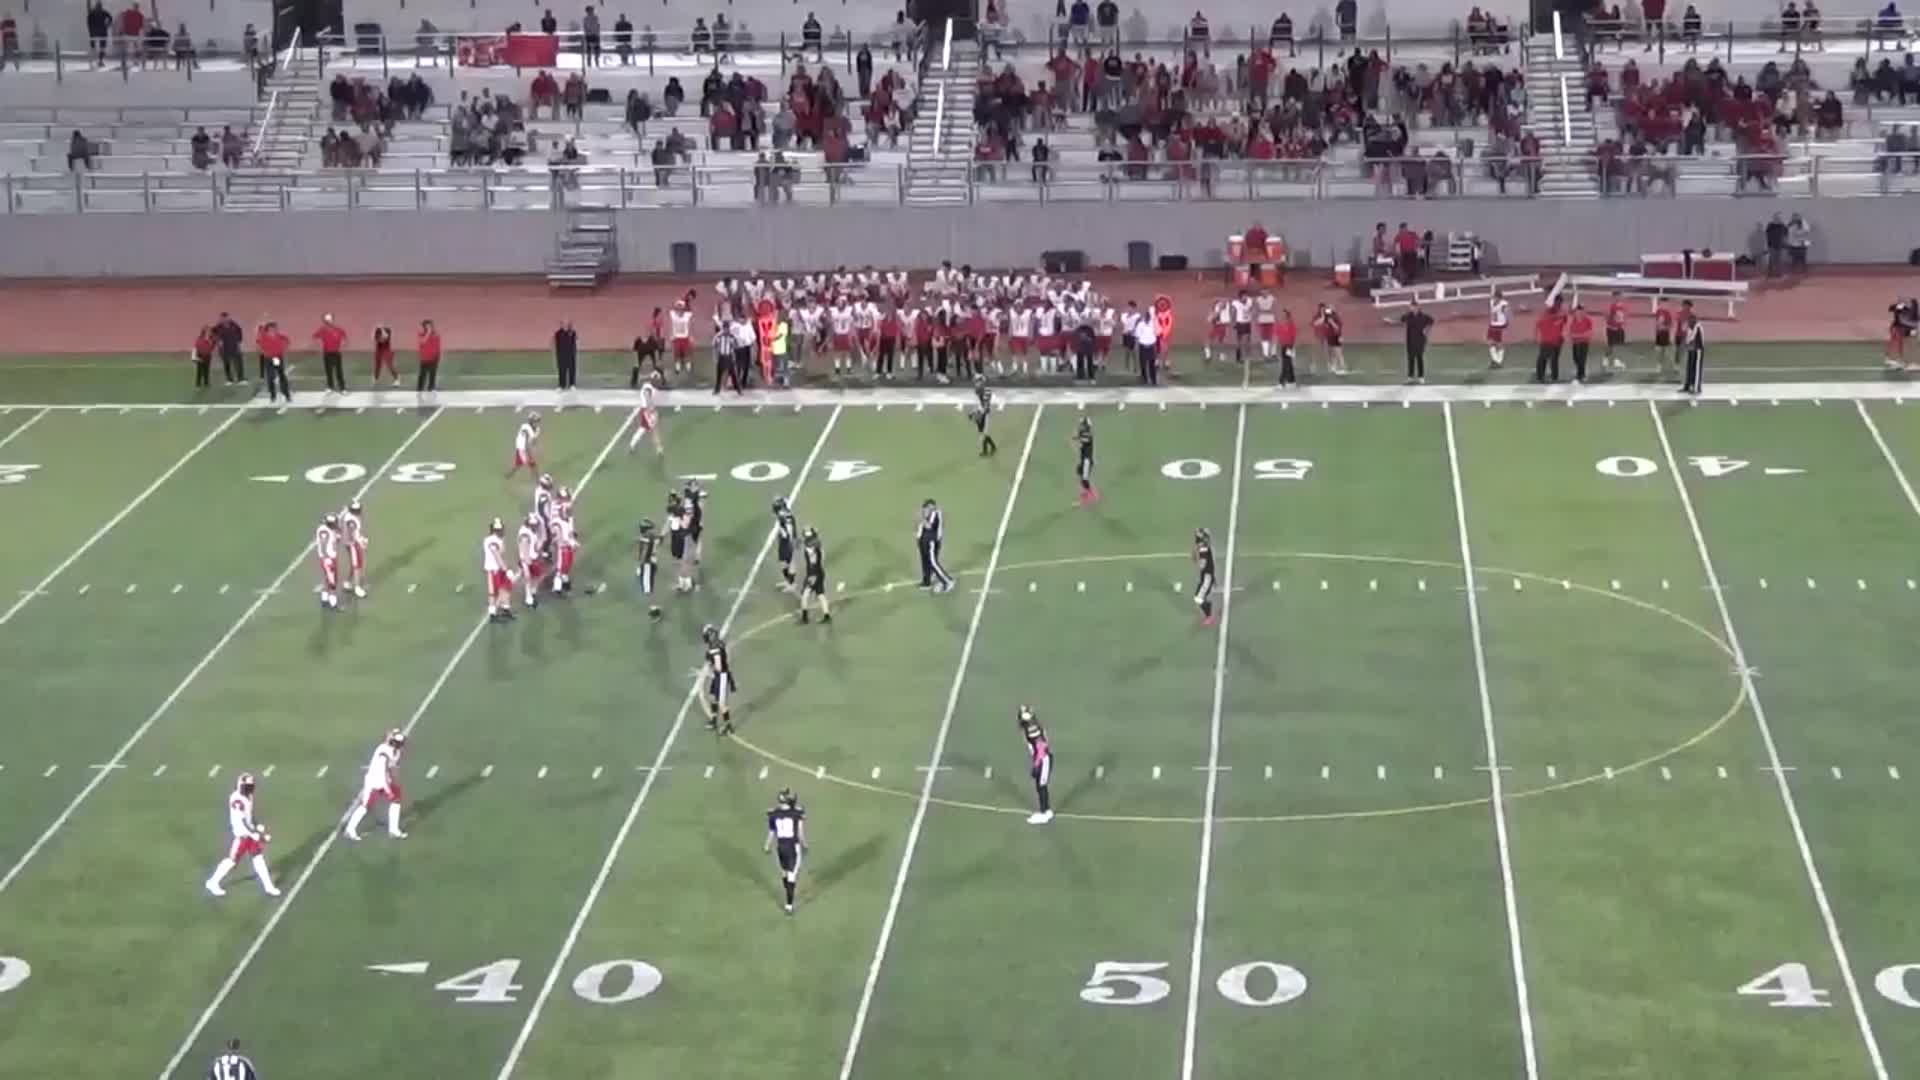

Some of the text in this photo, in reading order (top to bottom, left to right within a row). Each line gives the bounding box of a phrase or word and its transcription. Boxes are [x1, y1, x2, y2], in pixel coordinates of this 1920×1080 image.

[304, 461, 457, 485] 30
[729, 459, 883, 482] 40
[1159, 457, 1316, 481] 50
[1595, 455, 1751, 478] 40
[435, 957, 663, 1005] 40
[1079, 960, 1308, 1007] 50
